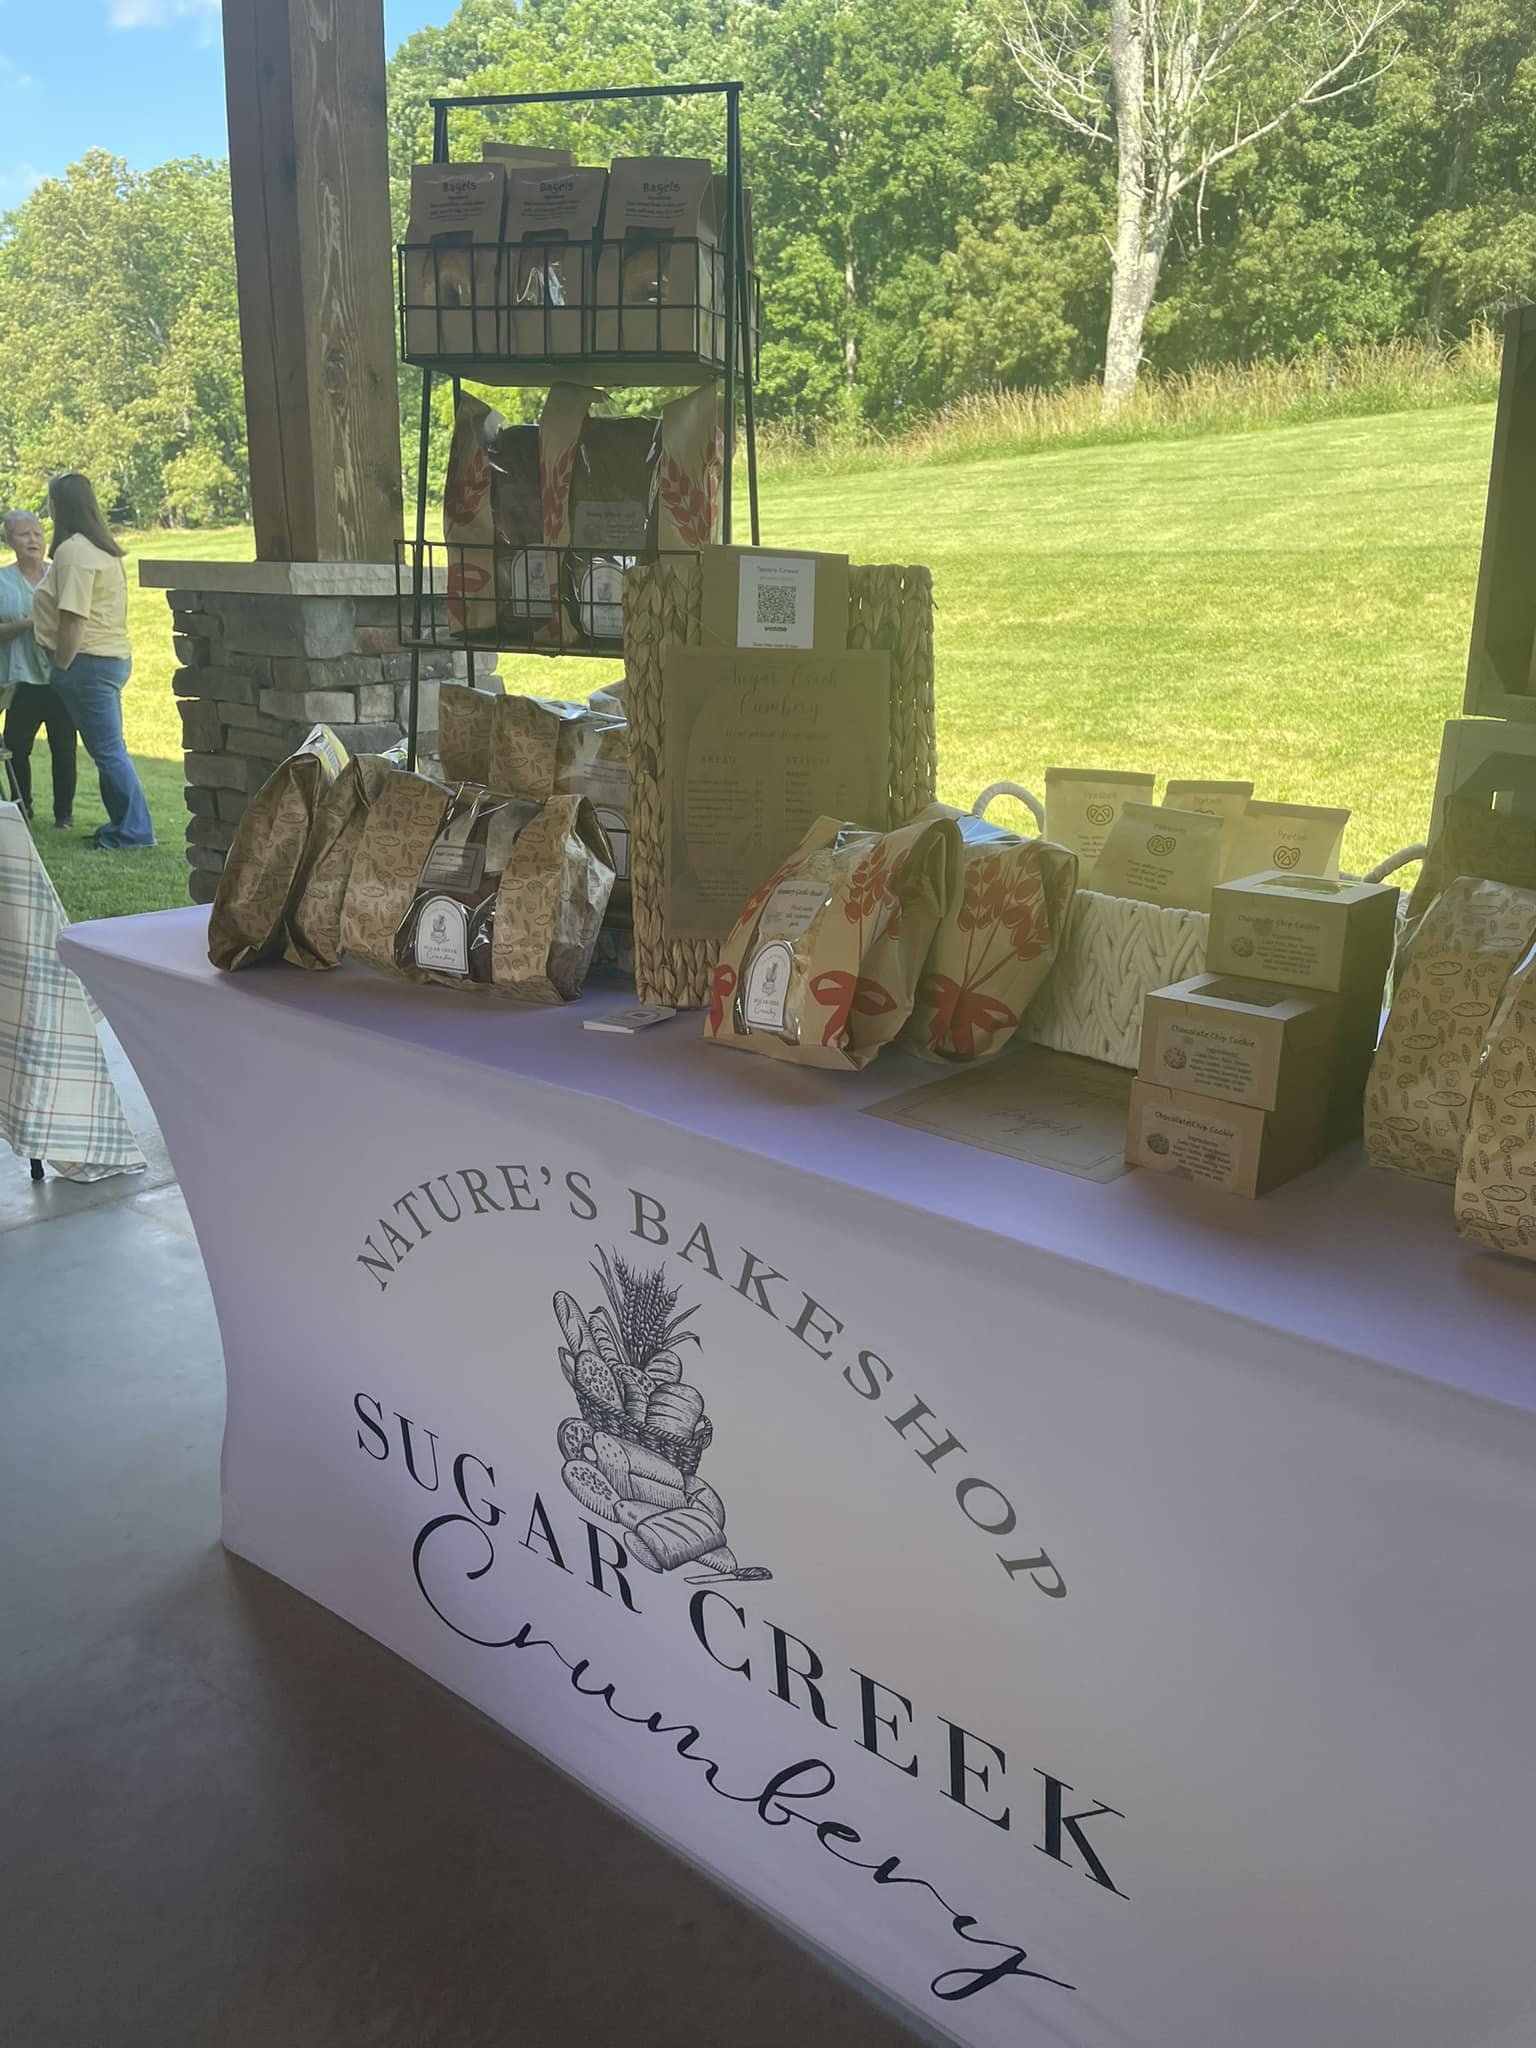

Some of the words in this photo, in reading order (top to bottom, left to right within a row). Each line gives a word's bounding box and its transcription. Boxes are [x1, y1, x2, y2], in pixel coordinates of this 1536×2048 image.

[442, 180, 477, 195] Bagels
[540, 180, 574, 195] Bagels
[643, 180, 681, 195] Bagels
[1170, 1023, 1209, 1038] Chocolate
[1210, 1031, 1227, 1043] Chip
[1229, 1035, 1256, 1048] Cookie
[1154, 1110, 1191, 1126] Chocolate
[1192, 1120, 1208, 1132] Chip
[1209, 1125, 1235, 1139] Cookie
[356, 1164, 598, 1292] NATURE'S
[628, 1187, 1069, 1600] BAKESHOP
[352, 1392, 643, 1614] SUGAR
[688, 1588, 1131, 1901] CREEK
[411, 1513, 1077, 2001] Crumbery
